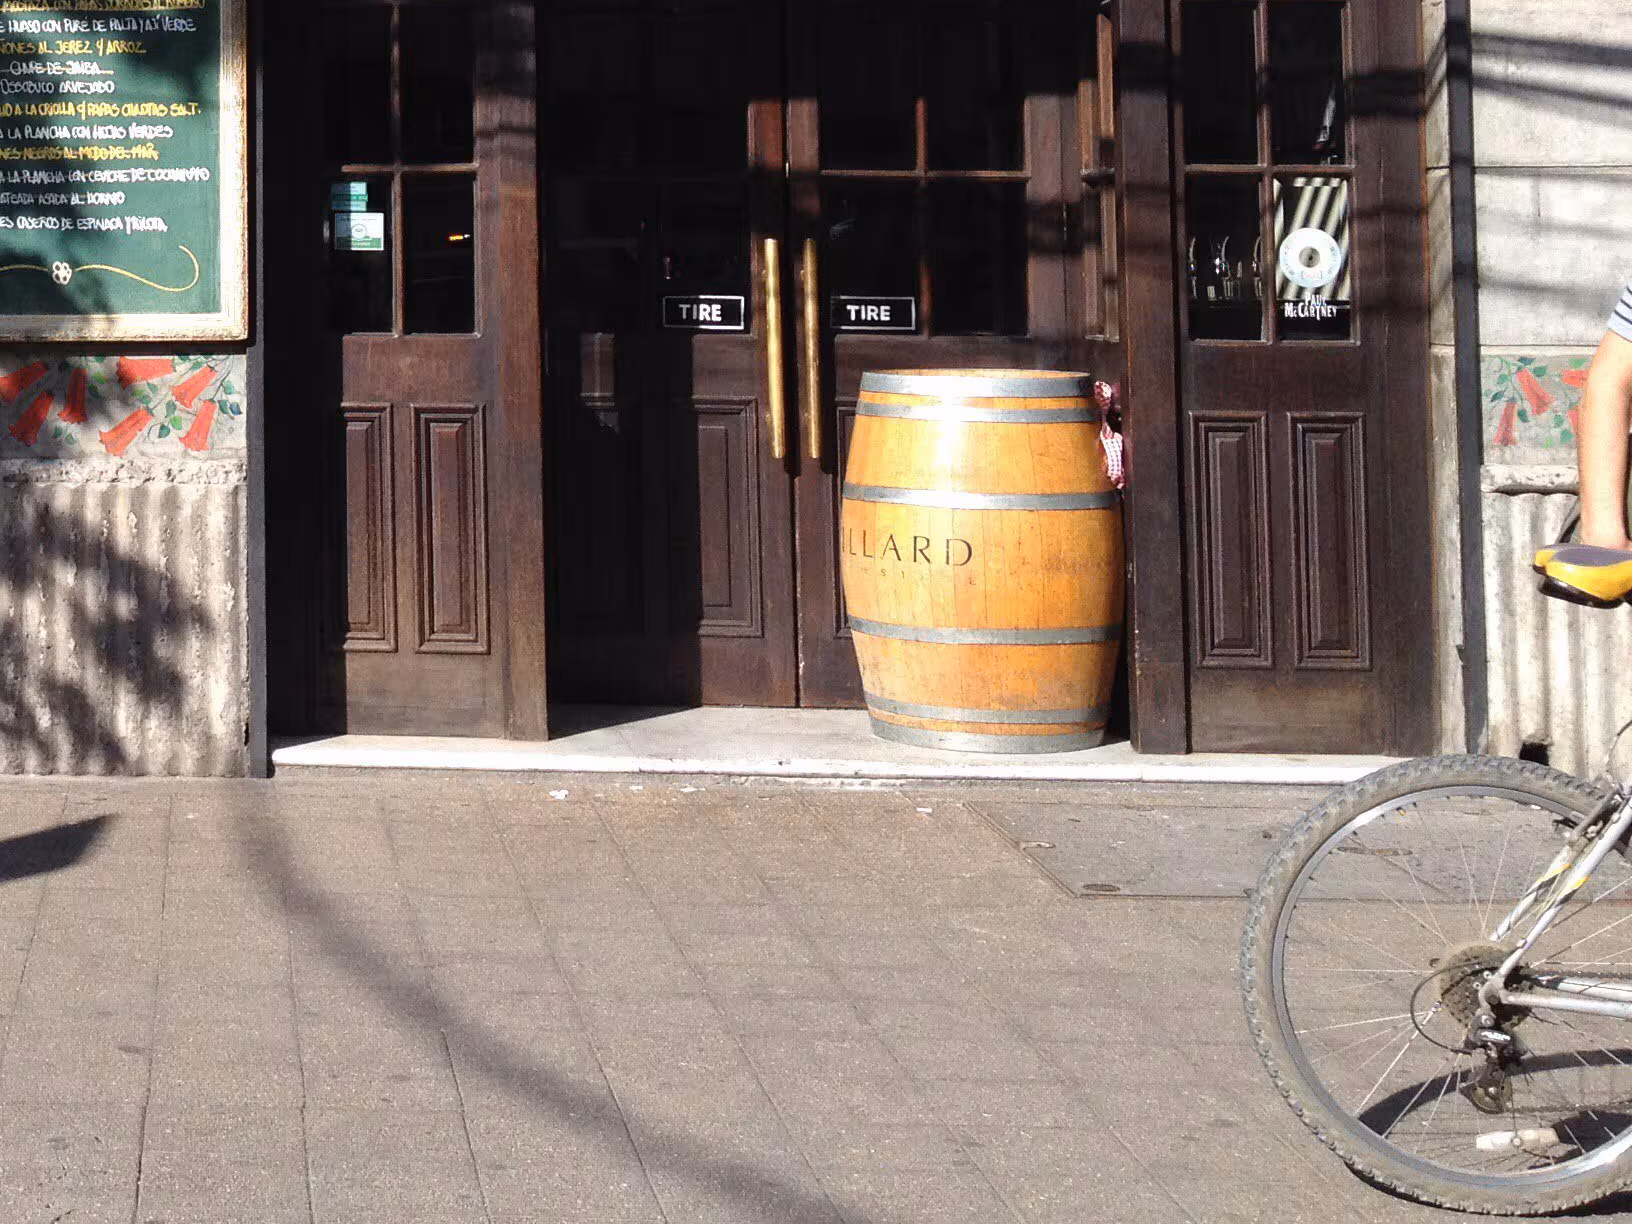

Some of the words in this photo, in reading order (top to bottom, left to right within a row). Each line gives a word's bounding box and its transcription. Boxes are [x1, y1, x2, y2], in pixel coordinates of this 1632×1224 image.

[42, 20, 62, 33] CON
[93, 20, 107, 33] DE
[161, 16, 196, 32] VERDE
[37, 40, 53, 54] AL
[55, 39, 93, 54] JEREZ
[106, 40, 147, 55] ARROZ
[47, 61, 64, 75] DE
[0, 78, 54, 94] OSSOBUCO
[59, 80, 115, 94] ARVEJADO
[25, 103, 37, 115] LA
[8, 128, 21, 139] LA
[24, 125, 70, 139] PLANCHA
[7, 170, 21, 183] LA
[70, 192, 85, 204] AL
[61, 217, 74, 230] DE
[678, 304, 722, 322] TIRE
[846, 305, 891, 321] TIRE
